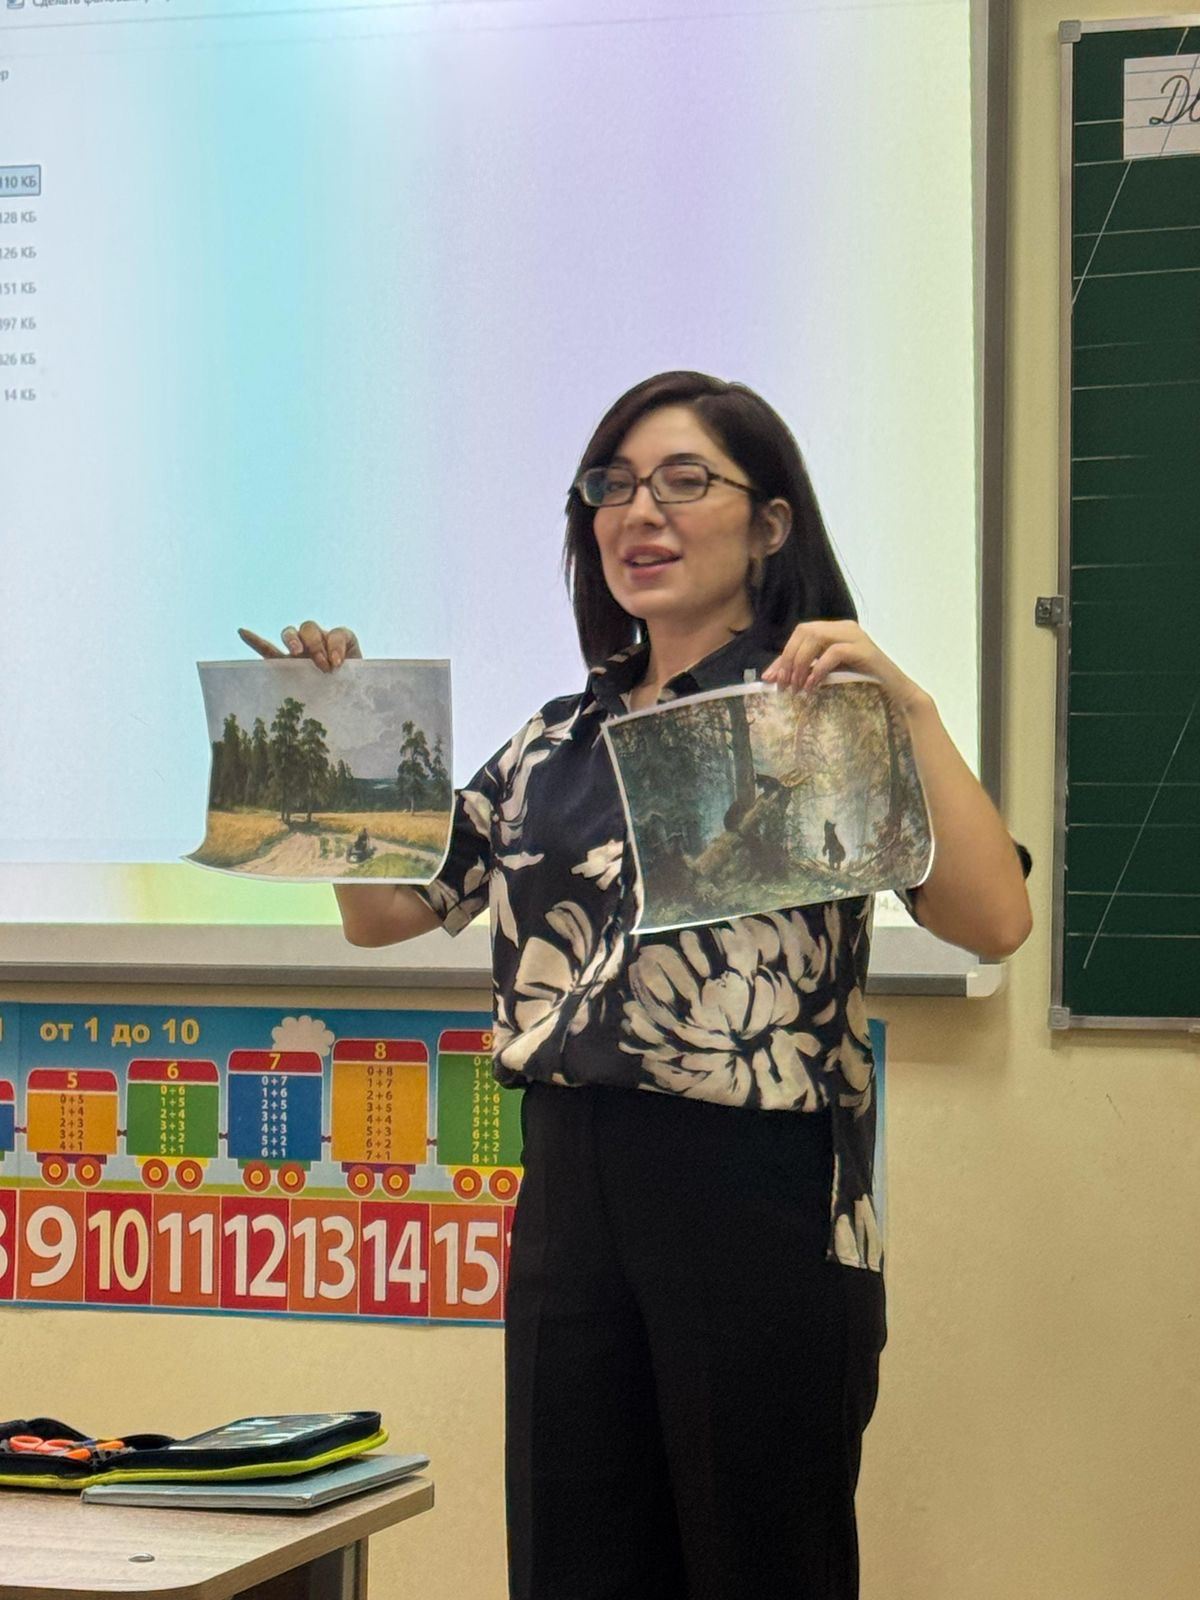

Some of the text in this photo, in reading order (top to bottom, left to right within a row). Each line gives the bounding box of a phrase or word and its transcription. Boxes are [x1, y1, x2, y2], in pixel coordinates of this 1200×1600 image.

[20, 176, 37, 188] КБ
[20, 211, 37, 223] КБ
[20, 246, 37, 259] КБ
[20, 281, 37, 294] КБ
[20, 317, 37, 330] КБ
[20, 352, 37, 365] КБ
[4, 388, 37, 401] 14 КБ
[40, 1017, 200, 1047] от 1 до 10
[481, 1033, 493, 1050] 9
[374, 1042, 387, 1060] 8
[269, 1053, 281, 1070] 7
[167, 1063, 179, 1079] 6
[67, 1072, 78, 1089] 5
[26, 1205, 77, 1287] 9
[88, 1208, 150, 1291] 10
[157, 1212, 214, 1294] 11
[223, 1213, 286, 1297] 12
[293, 1215, 356, 1299] 13
[362, 1219, 427, 1303] 14
[433, 1221, 500, 1305] 15
